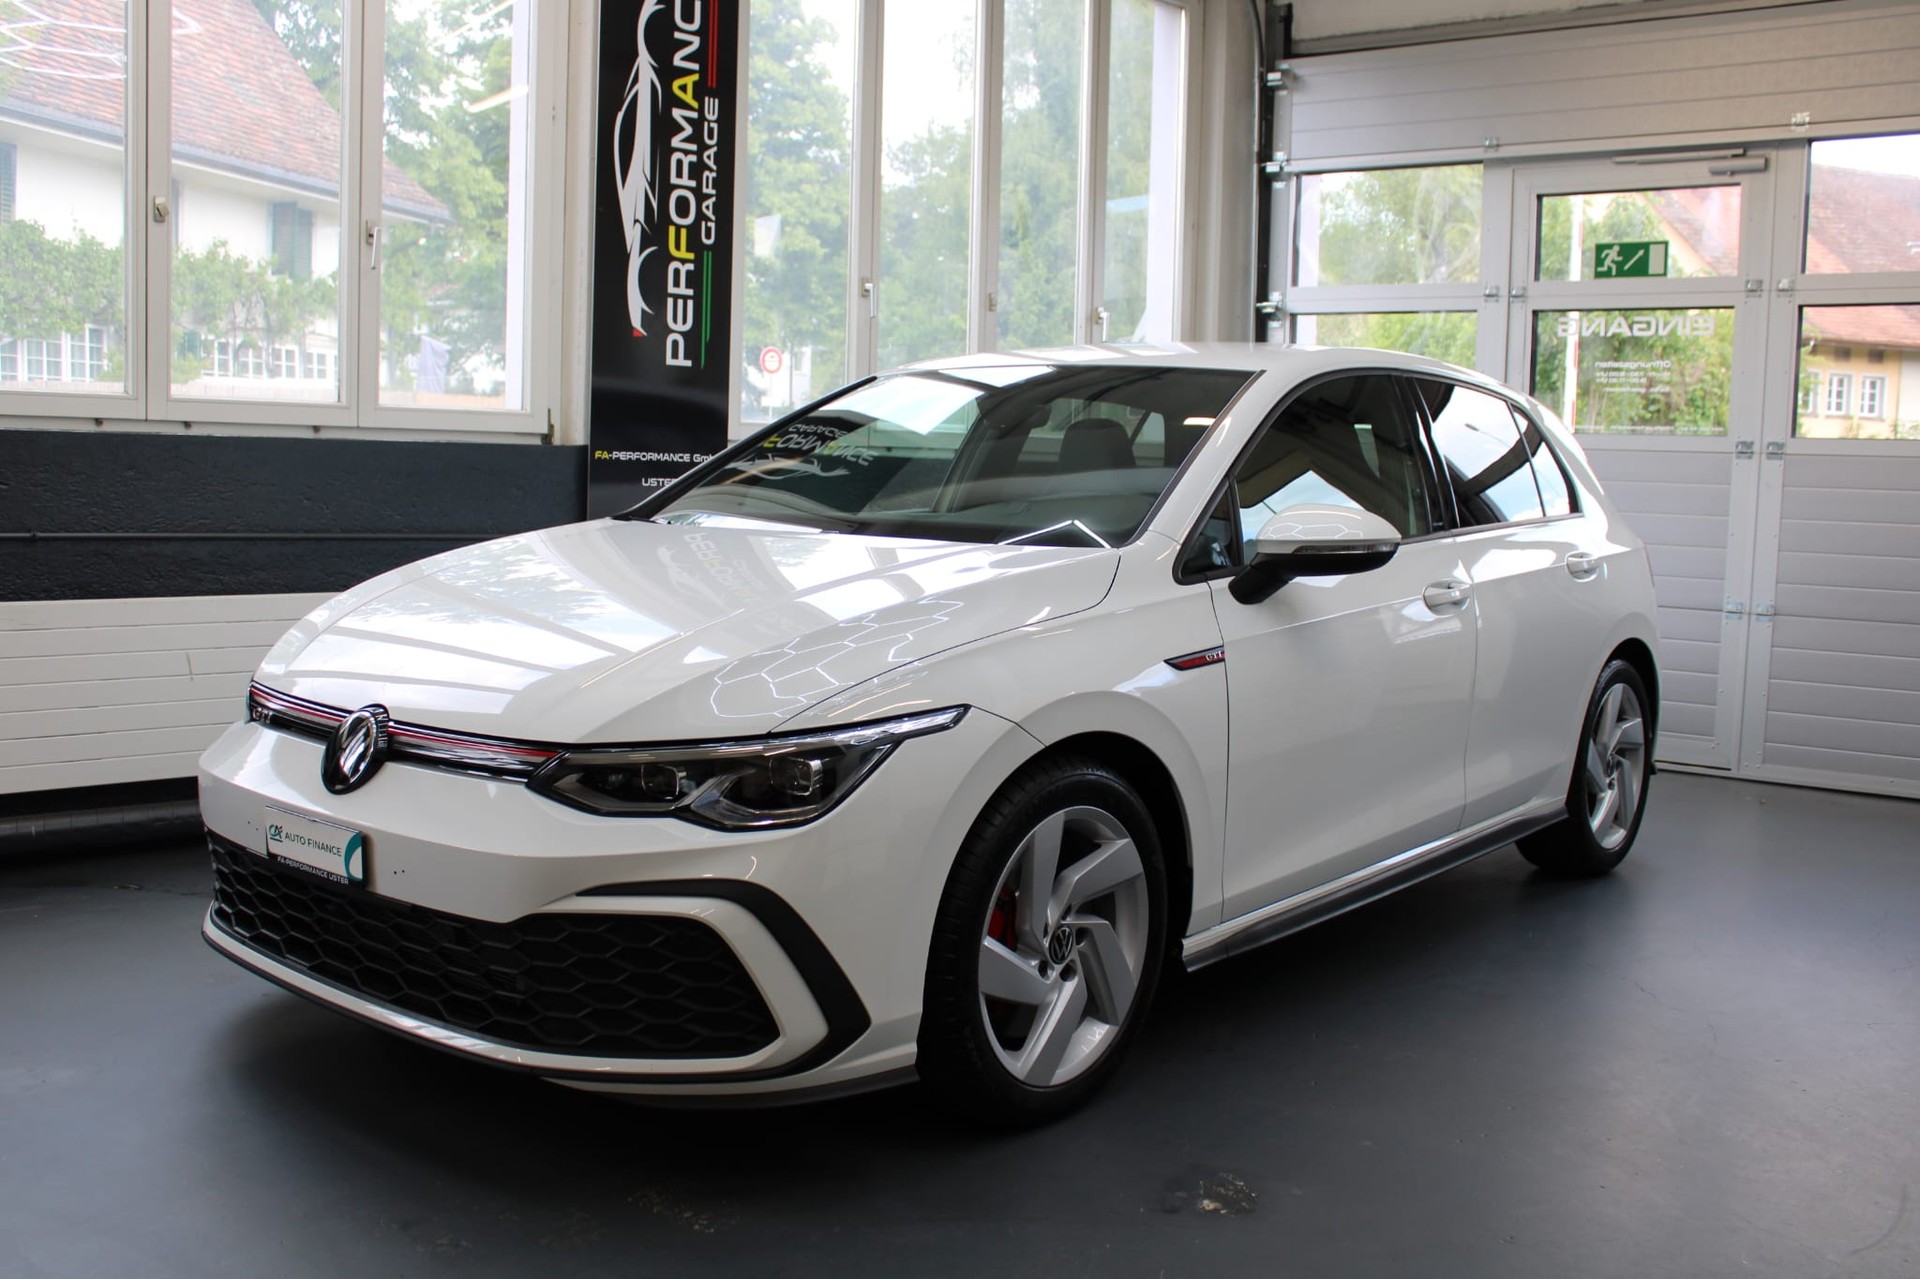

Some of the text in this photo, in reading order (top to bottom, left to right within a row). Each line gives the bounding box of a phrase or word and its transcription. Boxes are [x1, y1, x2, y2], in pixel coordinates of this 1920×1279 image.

[701, 96, 720, 246] GARAGE
[594, 450, 691, 462] FA-PERFORMANCE
[1205, 650, 1223, 661] GTI
[284, 831, 306, 846] AUTO
[307, 838, 343, 857] FINANCE
[277, 856, 349, 886] FA-PERFORMANCE USTER
